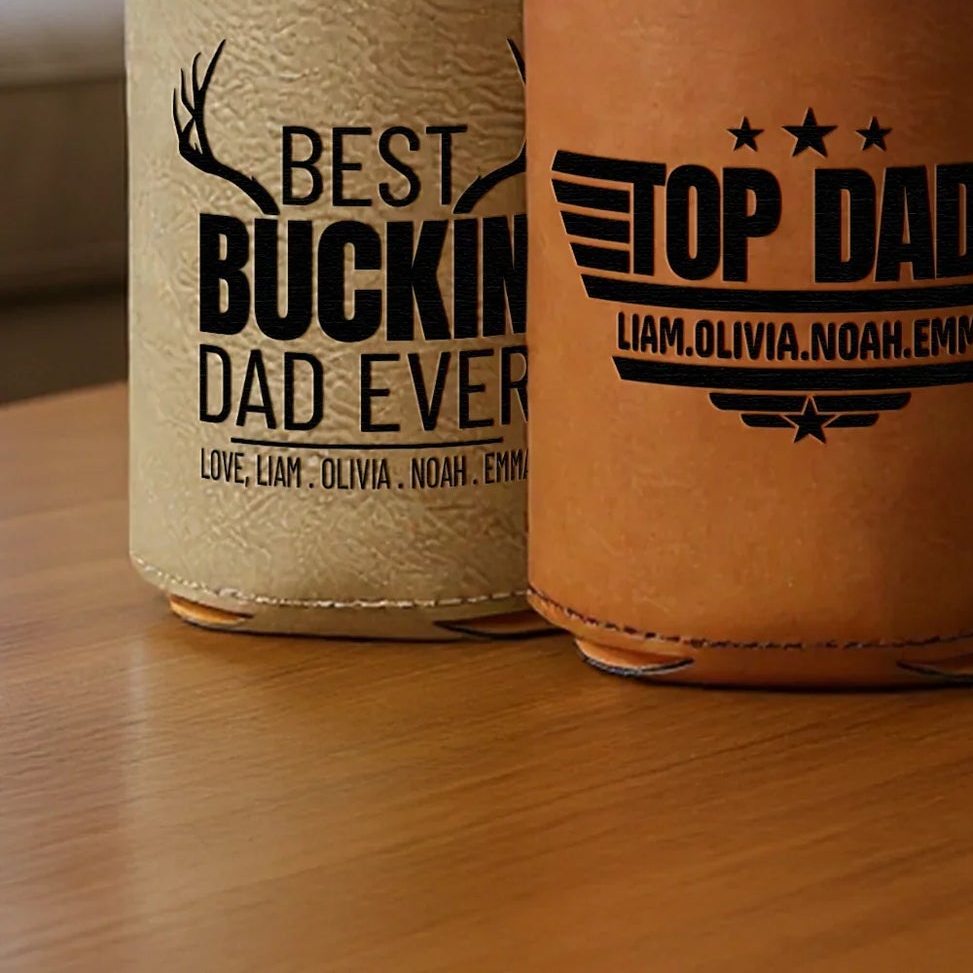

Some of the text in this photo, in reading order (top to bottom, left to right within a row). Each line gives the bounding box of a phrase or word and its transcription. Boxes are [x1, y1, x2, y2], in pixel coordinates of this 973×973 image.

[281, 125, 468, 208] BEST
[626, 163, 783, 283] TOP
[199, 213, 528, 343] BUCKIN
[199, 344, 528, 433] DAD EVER
[200, 447, 250, 487] LOVE,
[256, 452, 301, 488] LIAM
[321, 458, 390, 490] OLIVIA
[411, 456, 465, 489] NOAH
